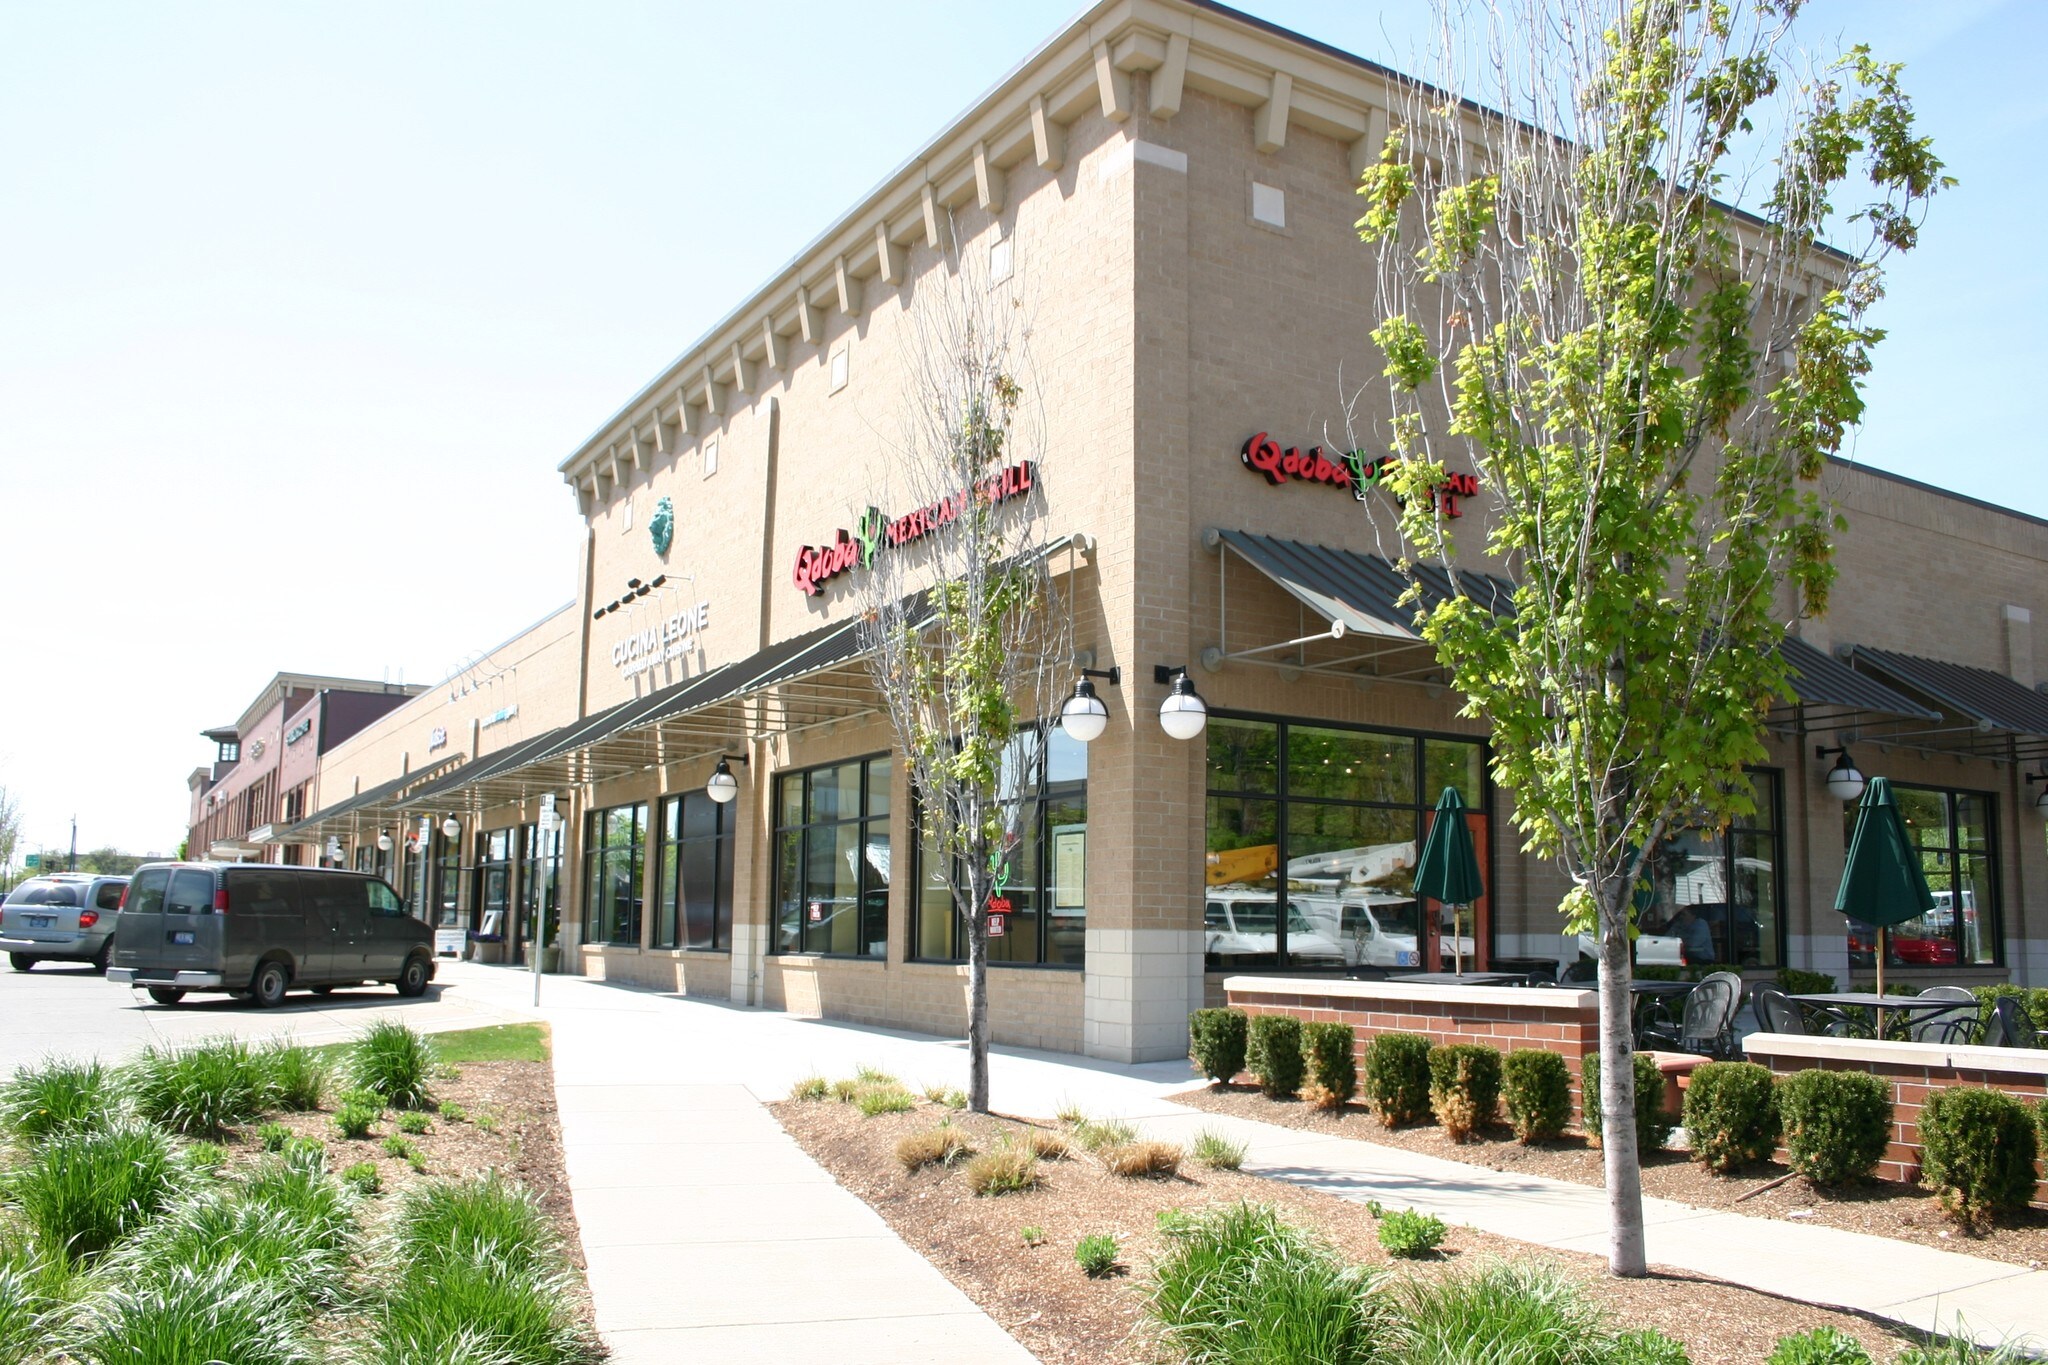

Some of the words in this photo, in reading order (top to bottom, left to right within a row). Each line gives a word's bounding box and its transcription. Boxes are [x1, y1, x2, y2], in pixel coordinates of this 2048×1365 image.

[1242, 431, 1351, 489] Qdoba
[793, 528, 860, 597] Qdoba
[973, 460, 1032, 506] RILL
[612, 625, 658, 667] CUCINA
[662, 600, 709, 644] LEONE
